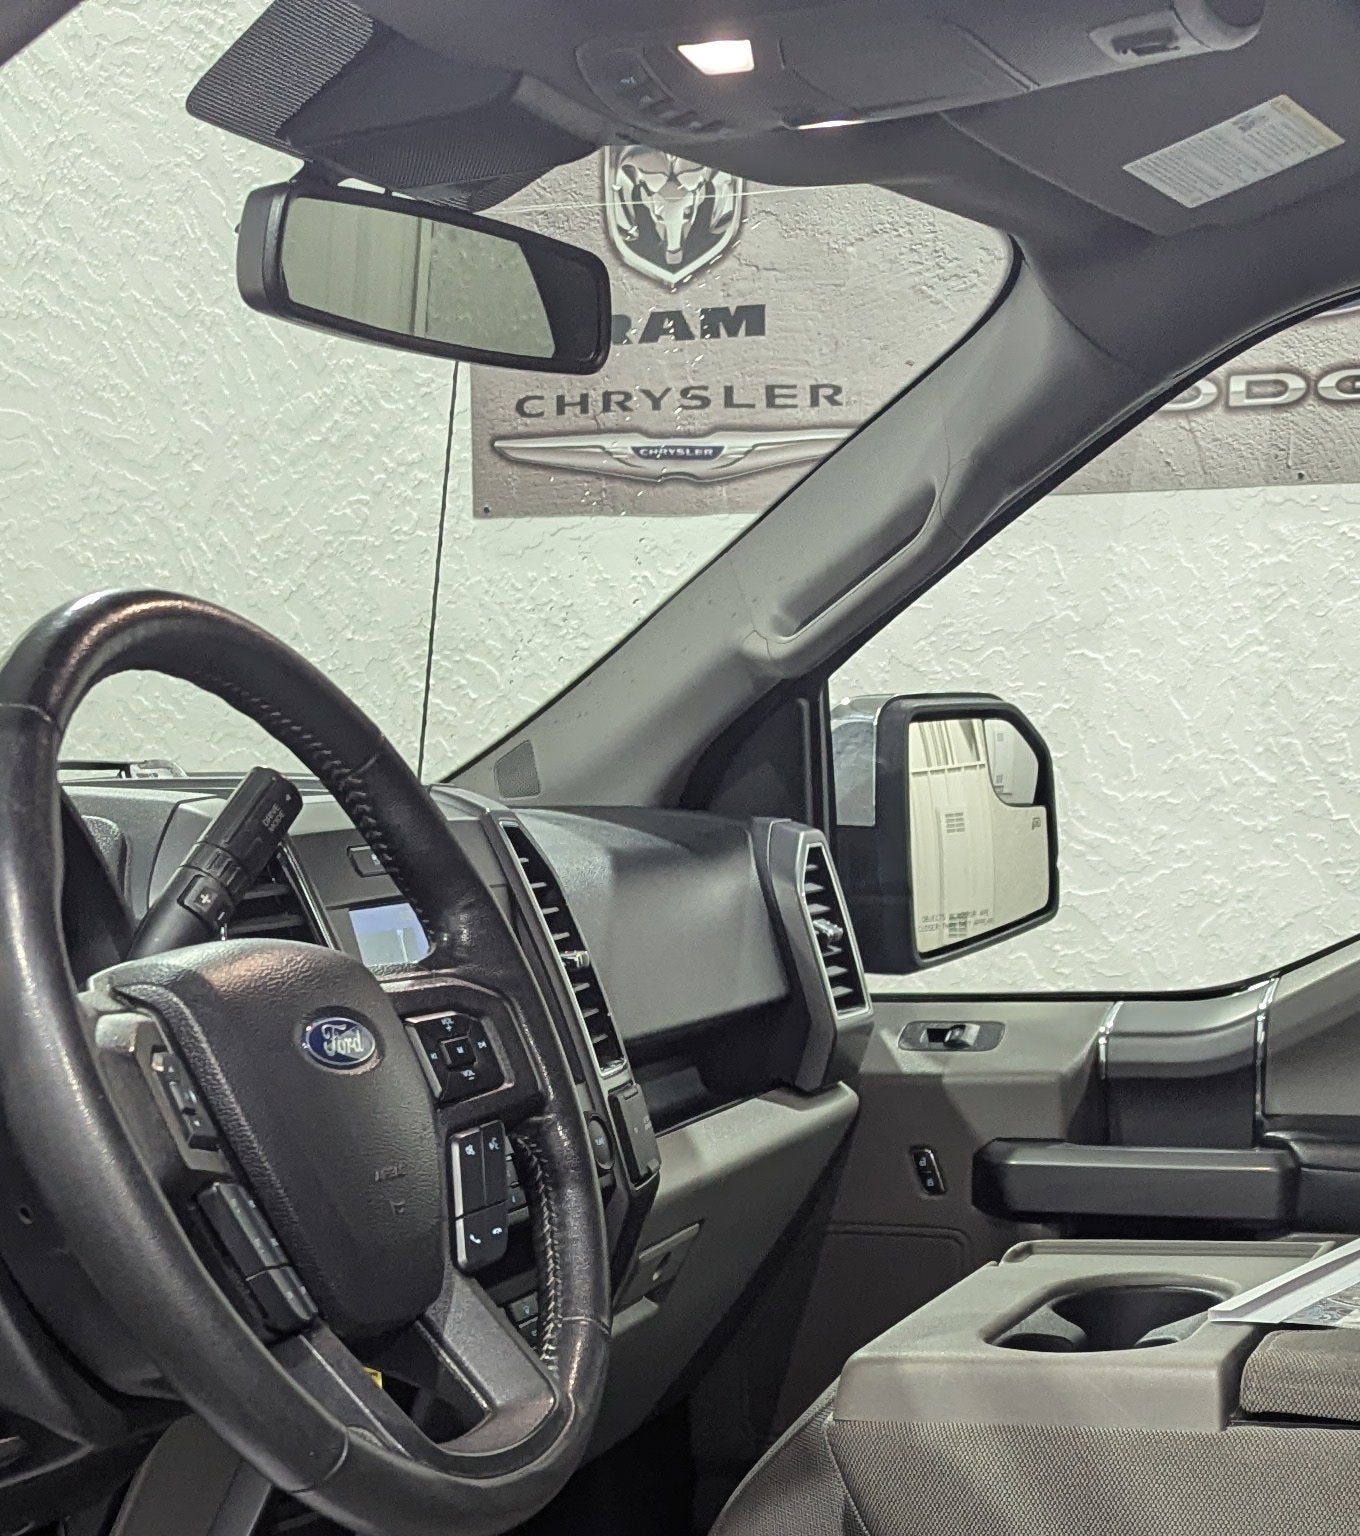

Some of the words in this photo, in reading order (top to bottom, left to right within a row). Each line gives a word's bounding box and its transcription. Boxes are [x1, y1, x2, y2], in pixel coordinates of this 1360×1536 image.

[515, 383, 844, 418] CHRYSLER
[639, 446, 714, 458] CHRYSLER
[321, 1023, 364, 1056] Ford
